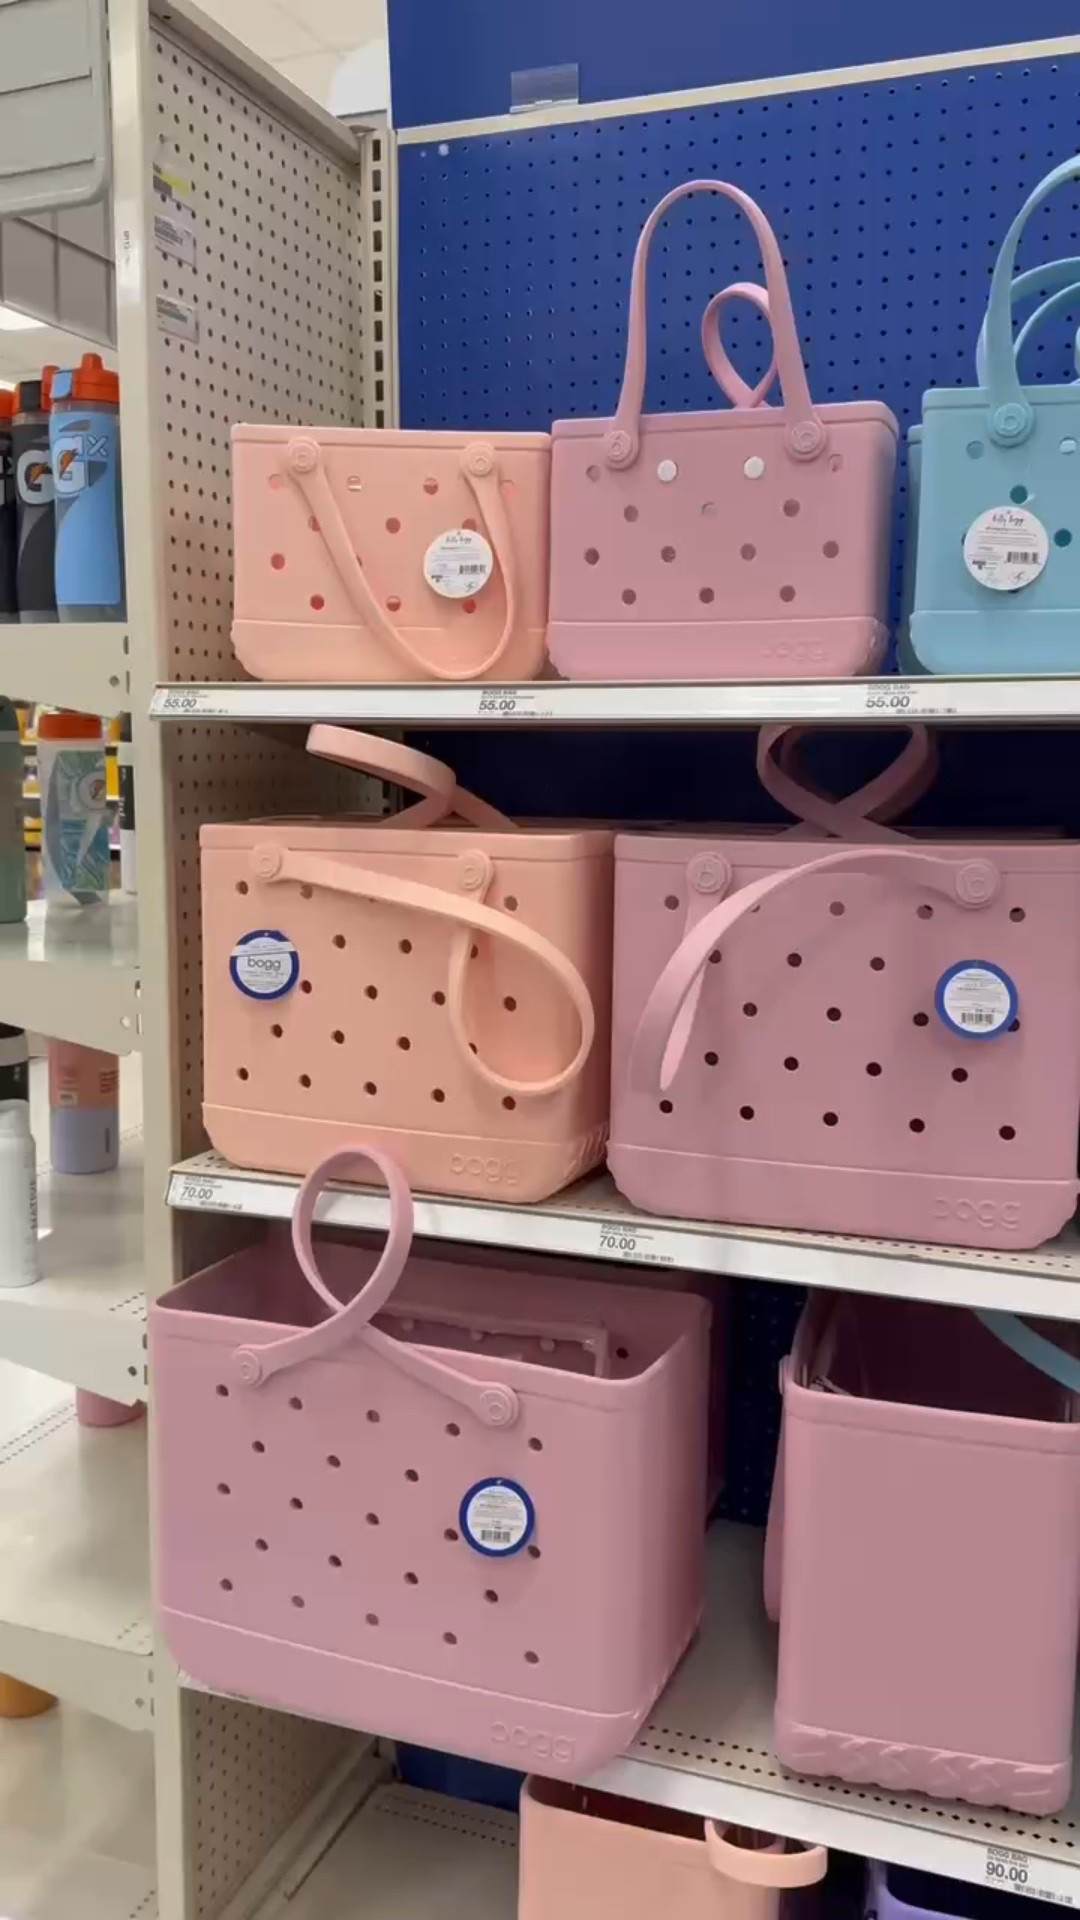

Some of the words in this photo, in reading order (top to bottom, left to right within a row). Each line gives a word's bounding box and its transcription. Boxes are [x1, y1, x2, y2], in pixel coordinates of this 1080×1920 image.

[163, 698, 198, 709] 55.00
[479, 699, 516, 711] 55.00
[866, 695, 910, 709] 55.00
[247, 955, 281, 971] bogg
[180, 1185, 214, 1201] 70.00
[599, 1235, 637, 1251] 70.00
[986, 1861, 1028, 1884] 90.00
